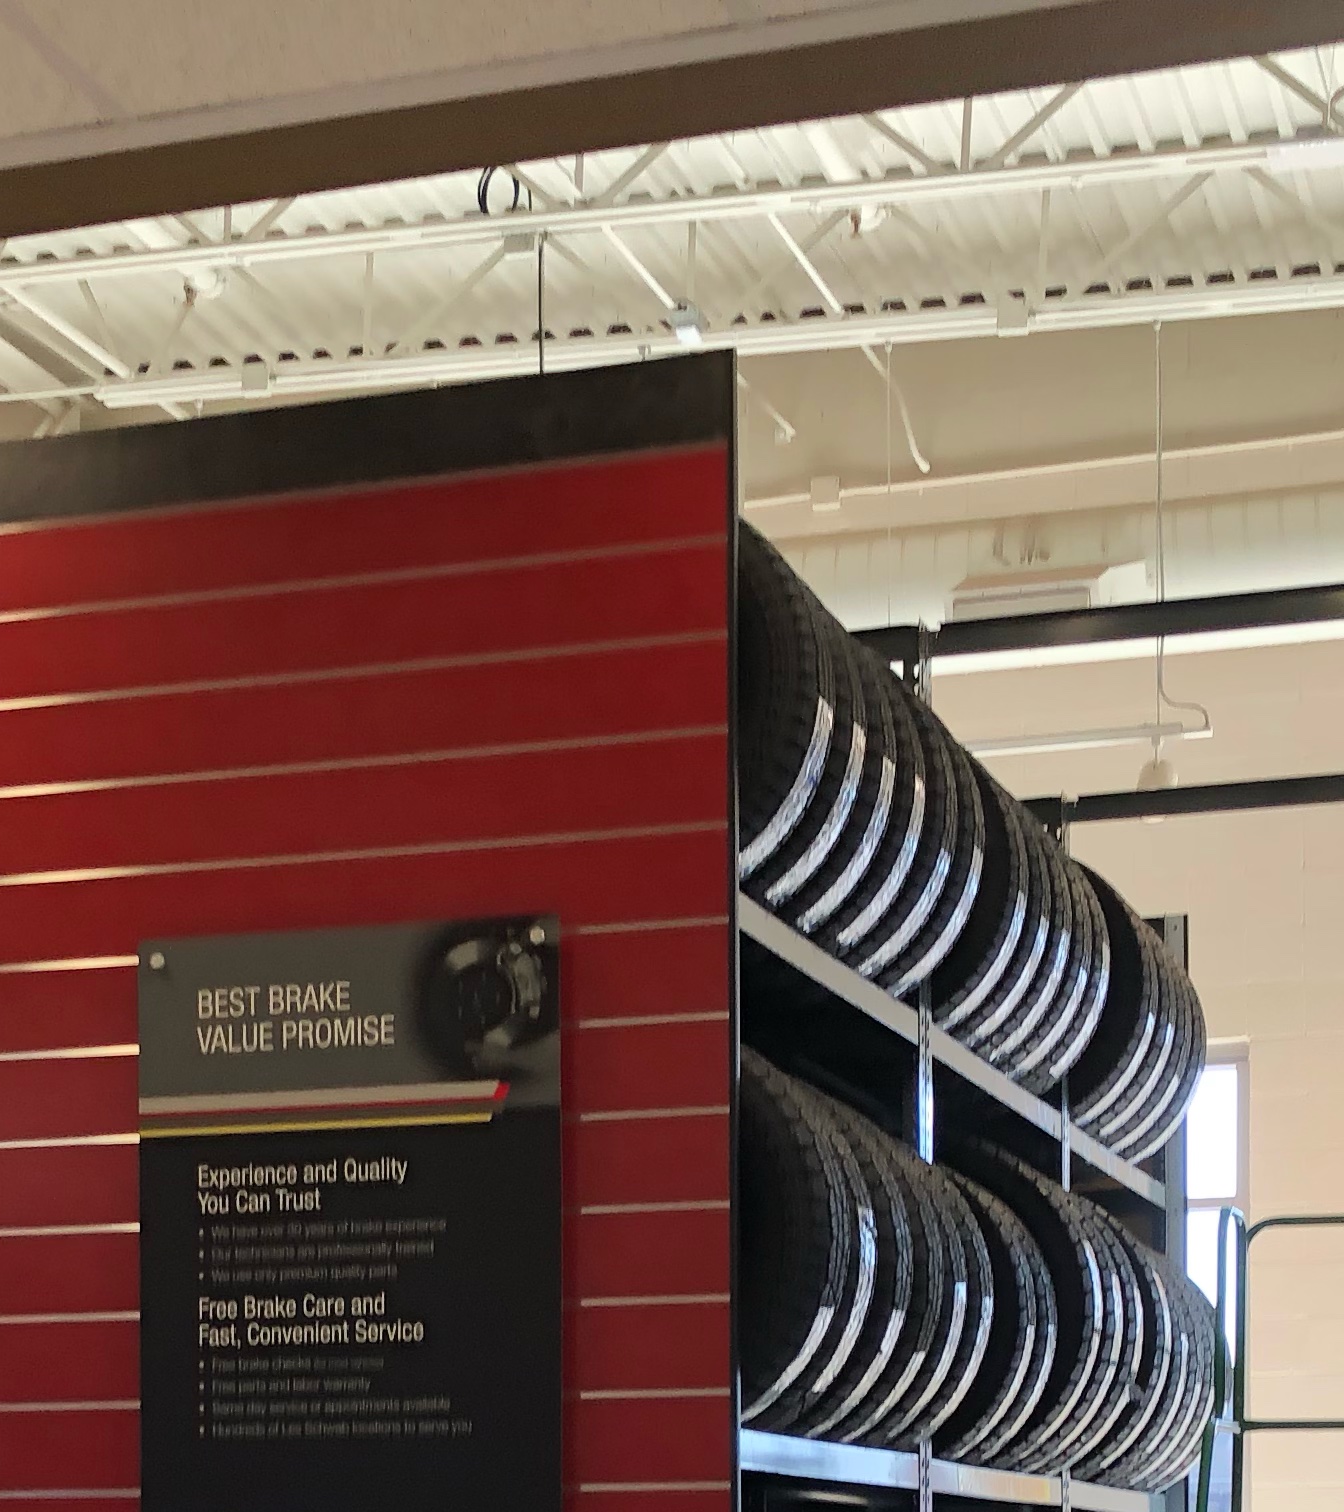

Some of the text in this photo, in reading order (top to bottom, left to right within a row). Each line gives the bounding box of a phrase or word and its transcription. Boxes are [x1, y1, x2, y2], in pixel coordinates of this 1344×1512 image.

[198, 981, 351, 1019] BEST BRAKE
[197, 1015, 395, 1054] VALUE PROMISE
[198, 1156, 407, 1190] Experience and Quality
[198, 1187, 321, 1215] You Can Trust
[199, 1291, 385, 1321] Free Brake Care and
[199, 1319, 424, 1350] Fast, Convenient Service
